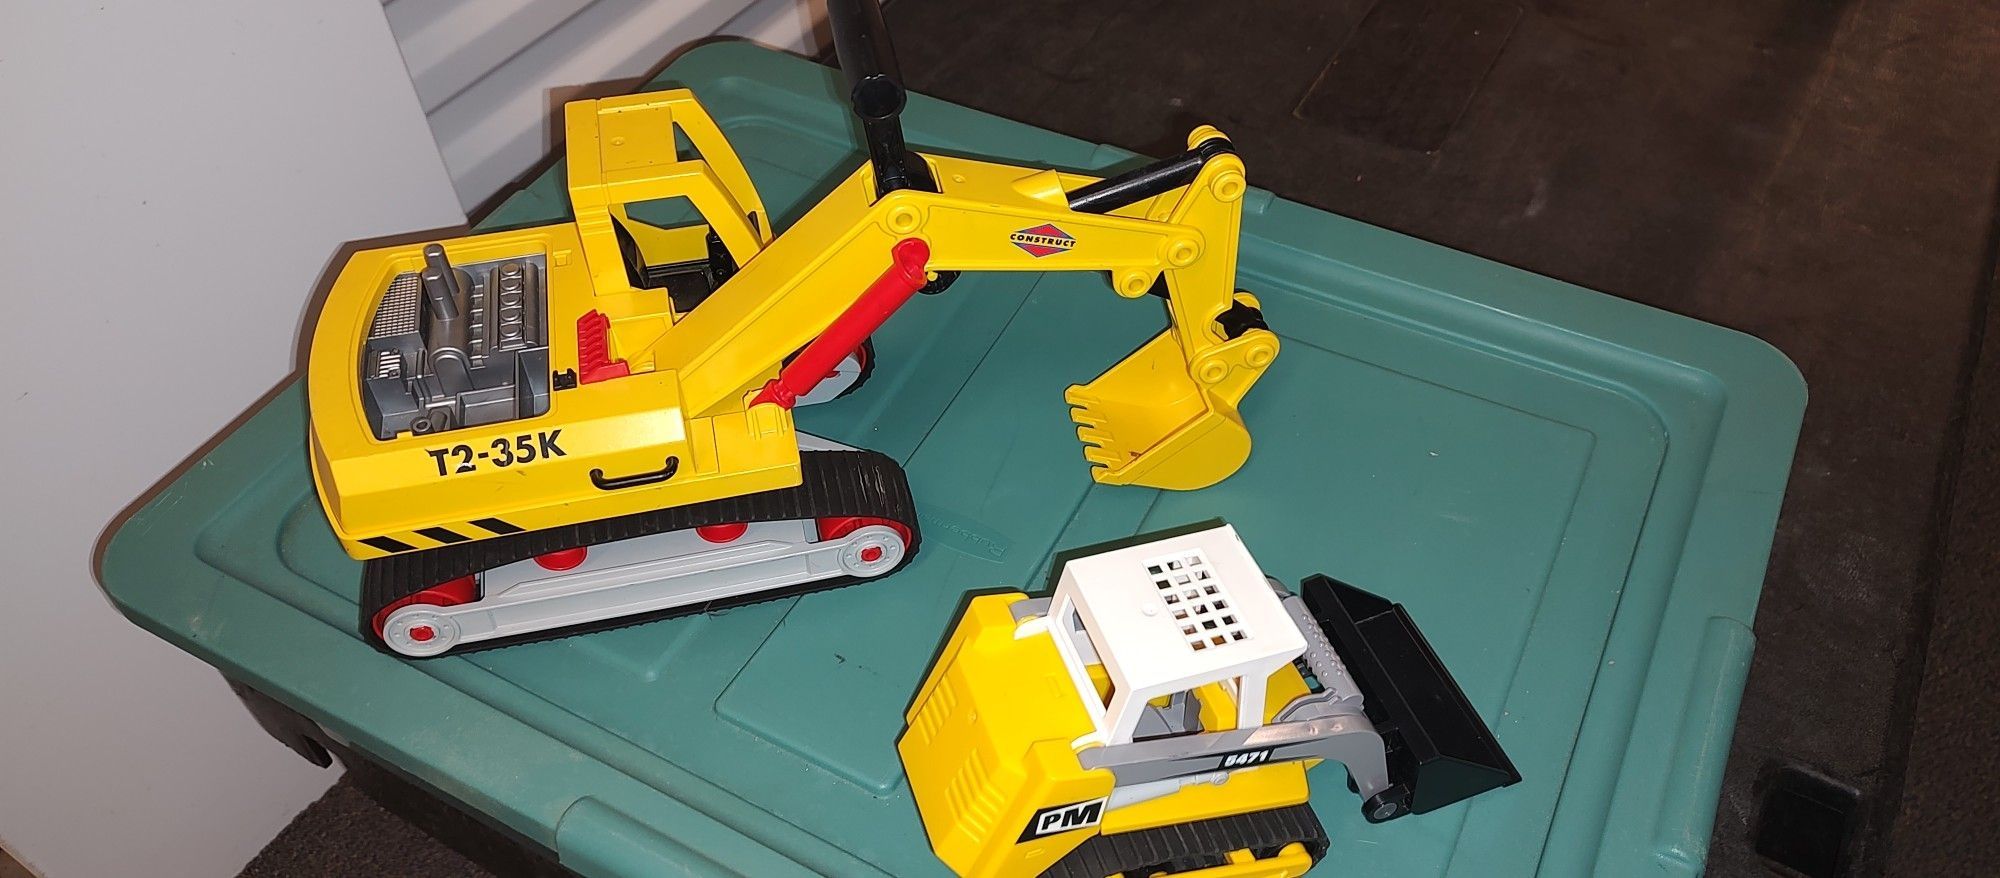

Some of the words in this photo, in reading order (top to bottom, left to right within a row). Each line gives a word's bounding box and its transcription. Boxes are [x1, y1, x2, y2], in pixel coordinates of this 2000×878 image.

[1010, 233, 1076, 248] CONSTRUCT
[425, 429, 567, 476] T2-35K
[1224, 750, 1269, 768] 5471
[1042, 801, 1104, 830] PM
